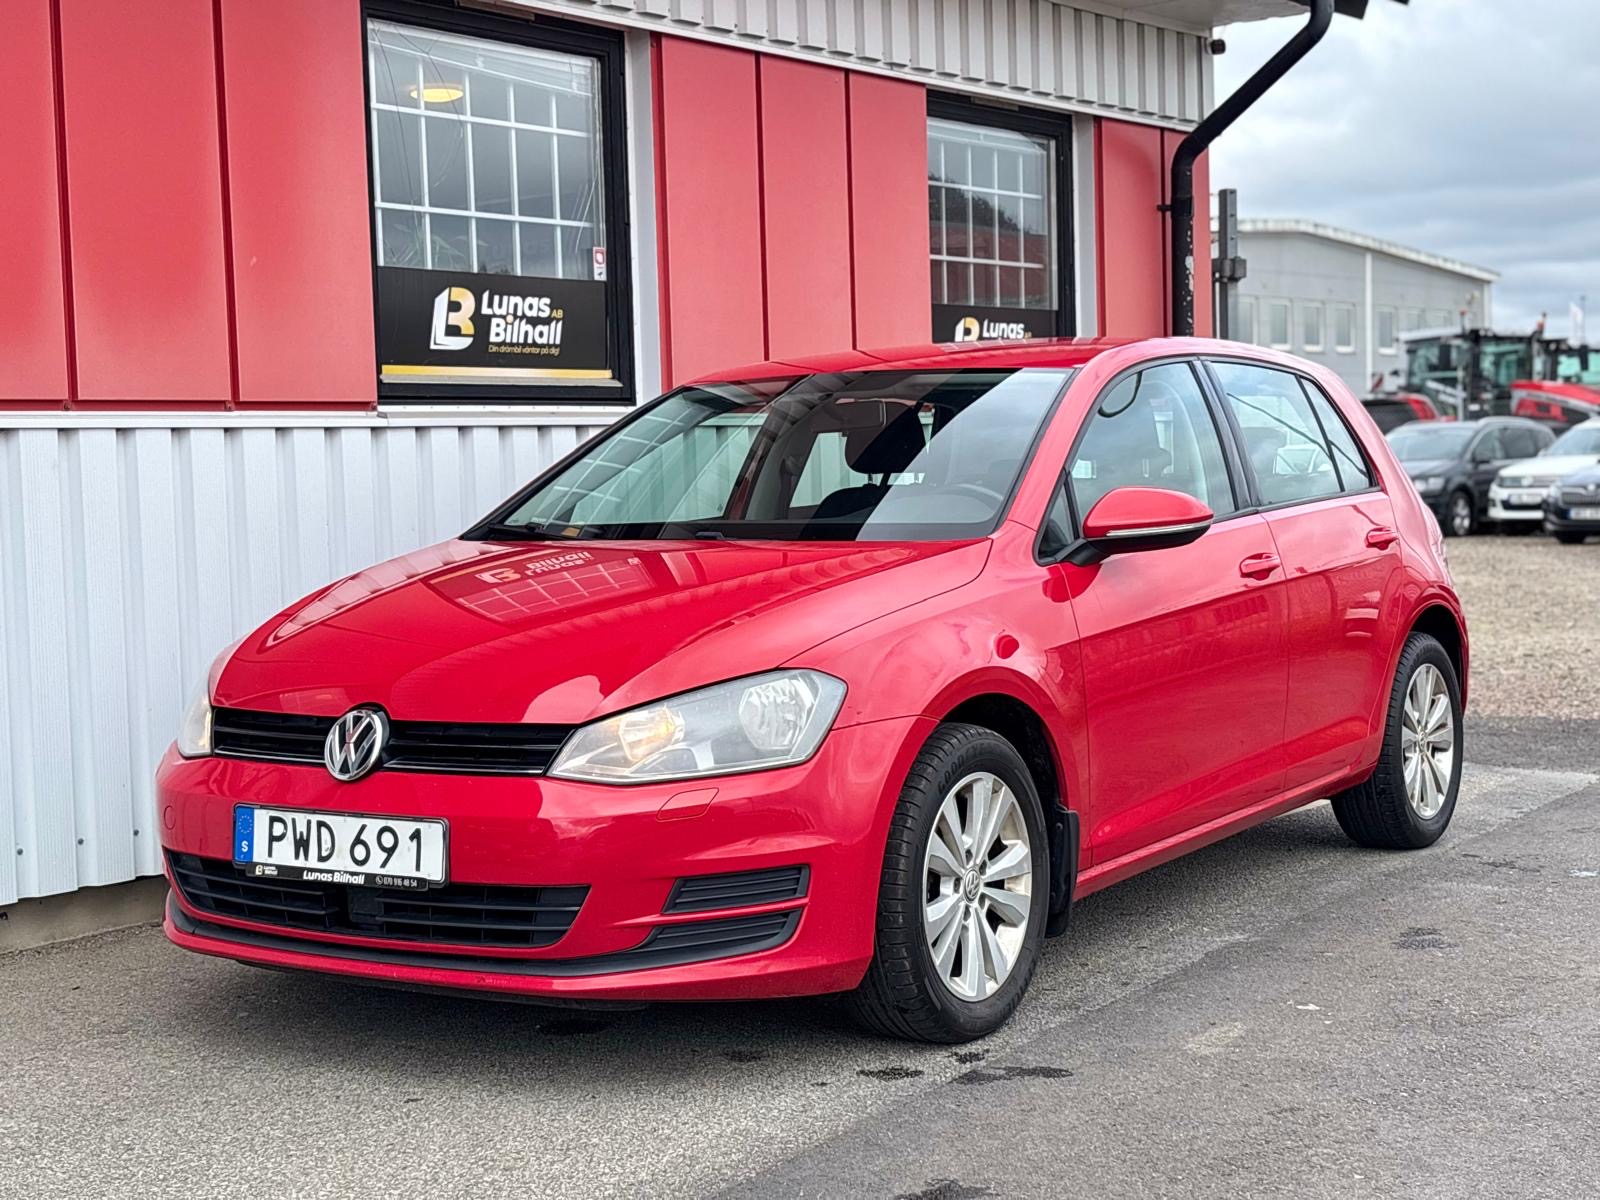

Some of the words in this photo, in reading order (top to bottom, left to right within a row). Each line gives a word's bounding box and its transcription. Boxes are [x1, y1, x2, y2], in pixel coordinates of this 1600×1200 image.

[481, 289, 551, 318] Lunas
[551, 309, 564, 319] AB
[489, 314, 563, 345] Bilhall
[982, 319, 1025, 339] Lunas
[488, 344, 499, 353] Din
[241, 841, 249, 853] S
[267, 815, 336, 863] PWD
[349, 823, 422, 873] 691
[303, 870, 333, 882] Lunas
[333, 870, 365, 885] Bilhall
